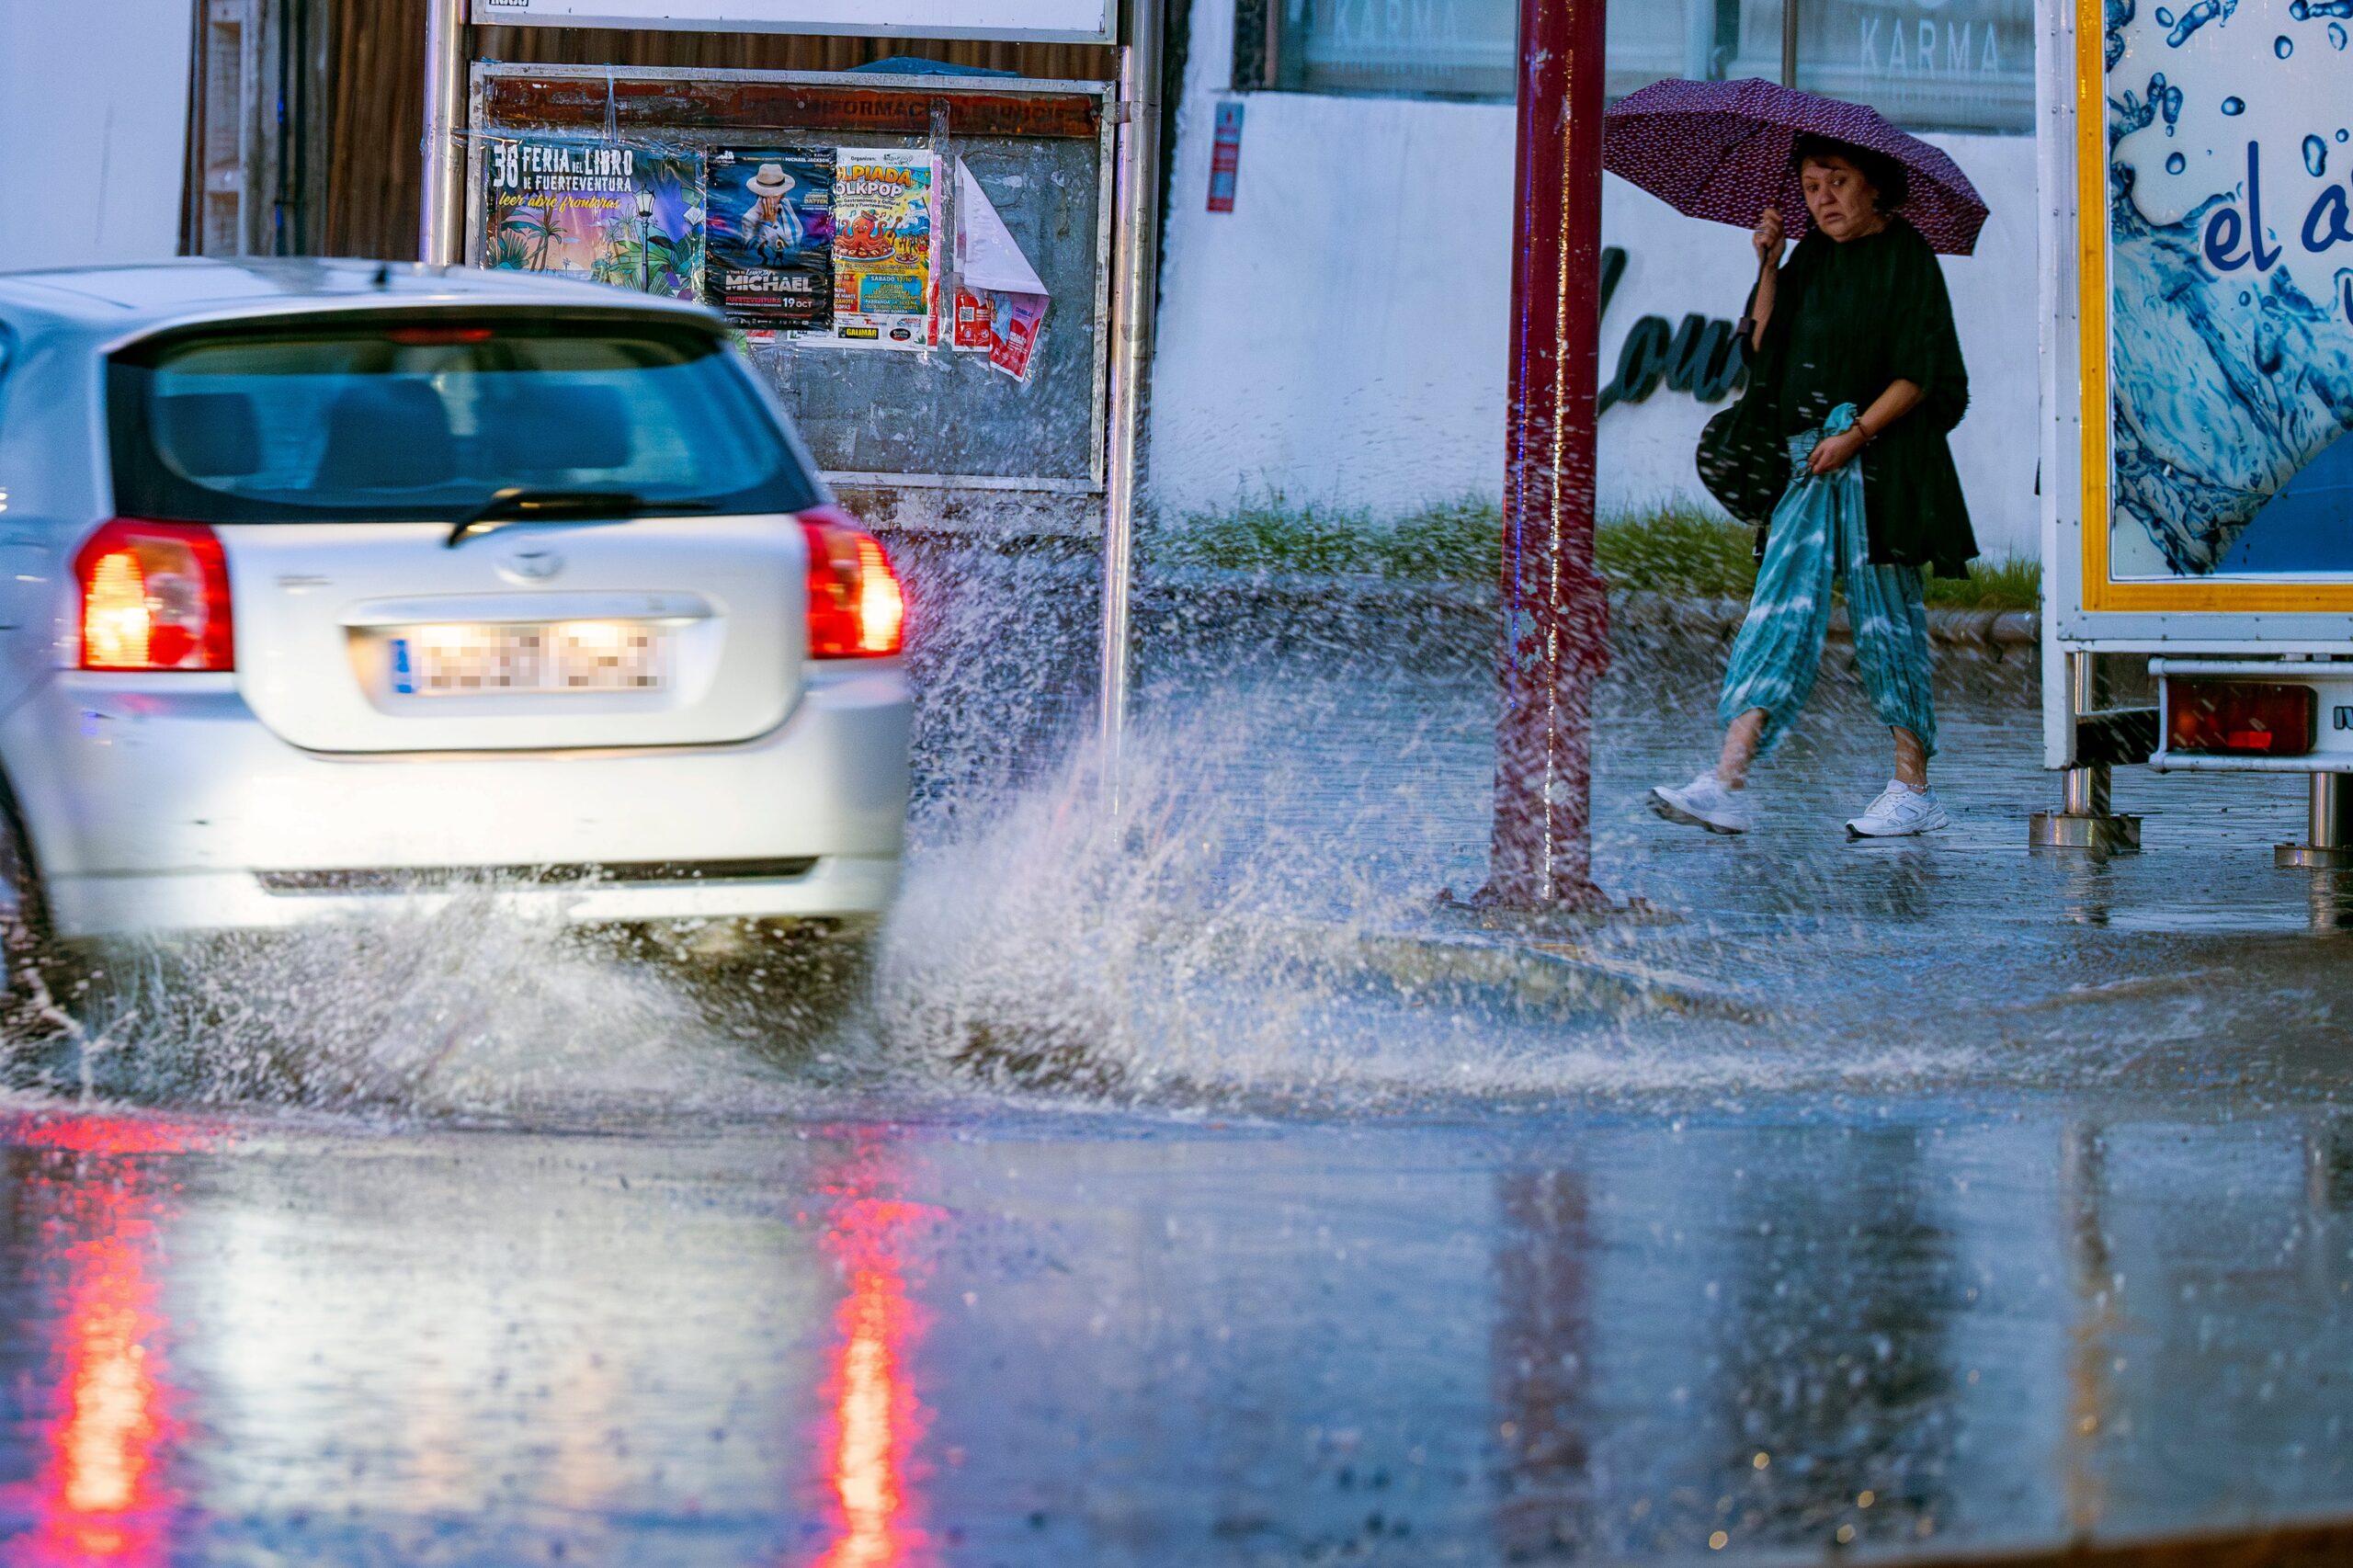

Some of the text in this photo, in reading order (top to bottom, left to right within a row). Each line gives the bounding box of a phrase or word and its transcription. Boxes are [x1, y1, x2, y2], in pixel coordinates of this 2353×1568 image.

[1860, 17, 2000, 80] KARMA
[522, 147, 571, 173] FERIA
[572, 162, 583, 174] DEL
[585, 148, 633, 176] LIBRO
[524, 176, 632, 192] DE FUERTEVENTURA
[499, 193, 621, 212] leer abre fronteras
[2205, 141, 2282, 272] el
[725, 275, 813, 292] MICHAEL
[782, 298, 795, 308] 19
[846, 328, 877, 337] GALIMAR
